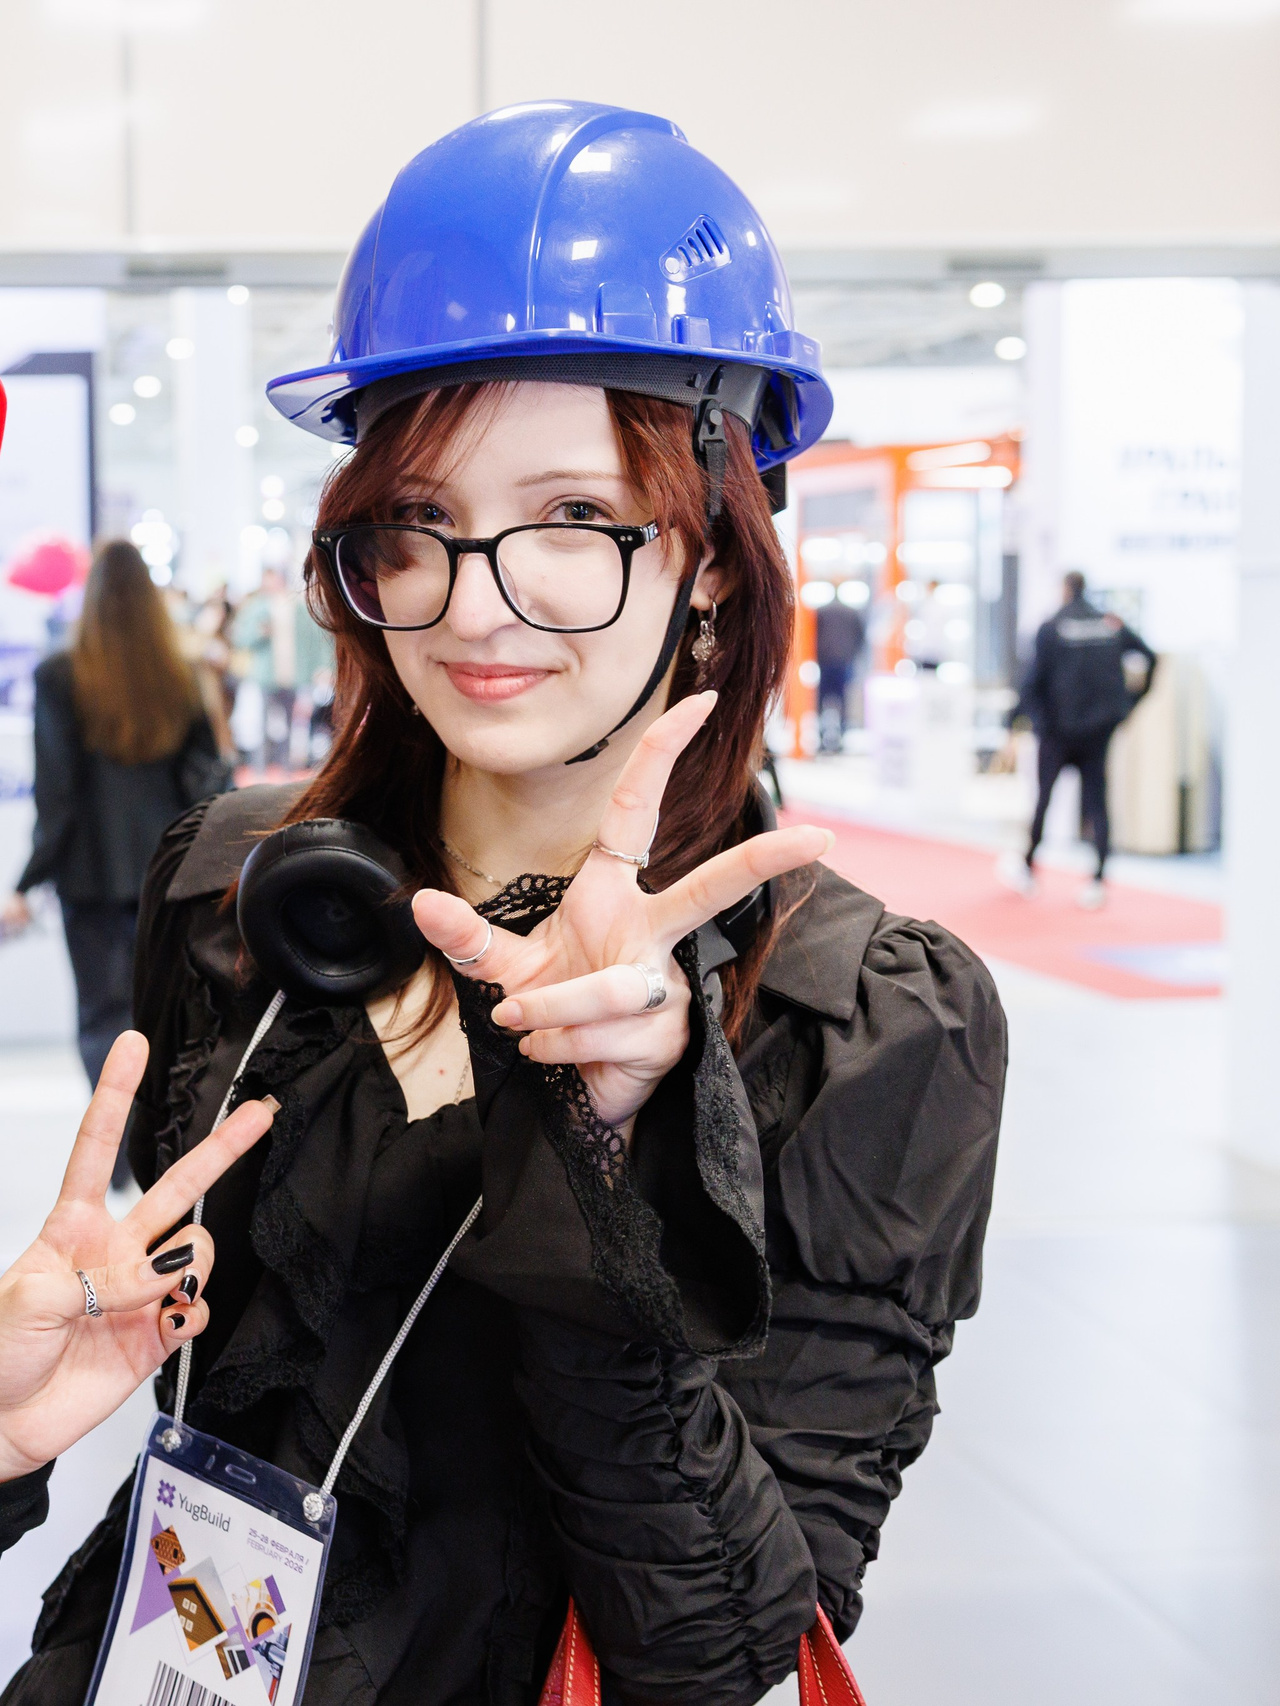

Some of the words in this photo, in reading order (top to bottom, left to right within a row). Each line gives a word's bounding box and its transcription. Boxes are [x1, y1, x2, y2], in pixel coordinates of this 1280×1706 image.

[178, 1493, 231, 1532] YugBuild
[246, 1537, 282, 1562] FEBRUARY
[284, 1557, 304, 1574] 2026
[270, 1540, 304, 1563] ФЕВРАЛЯ
